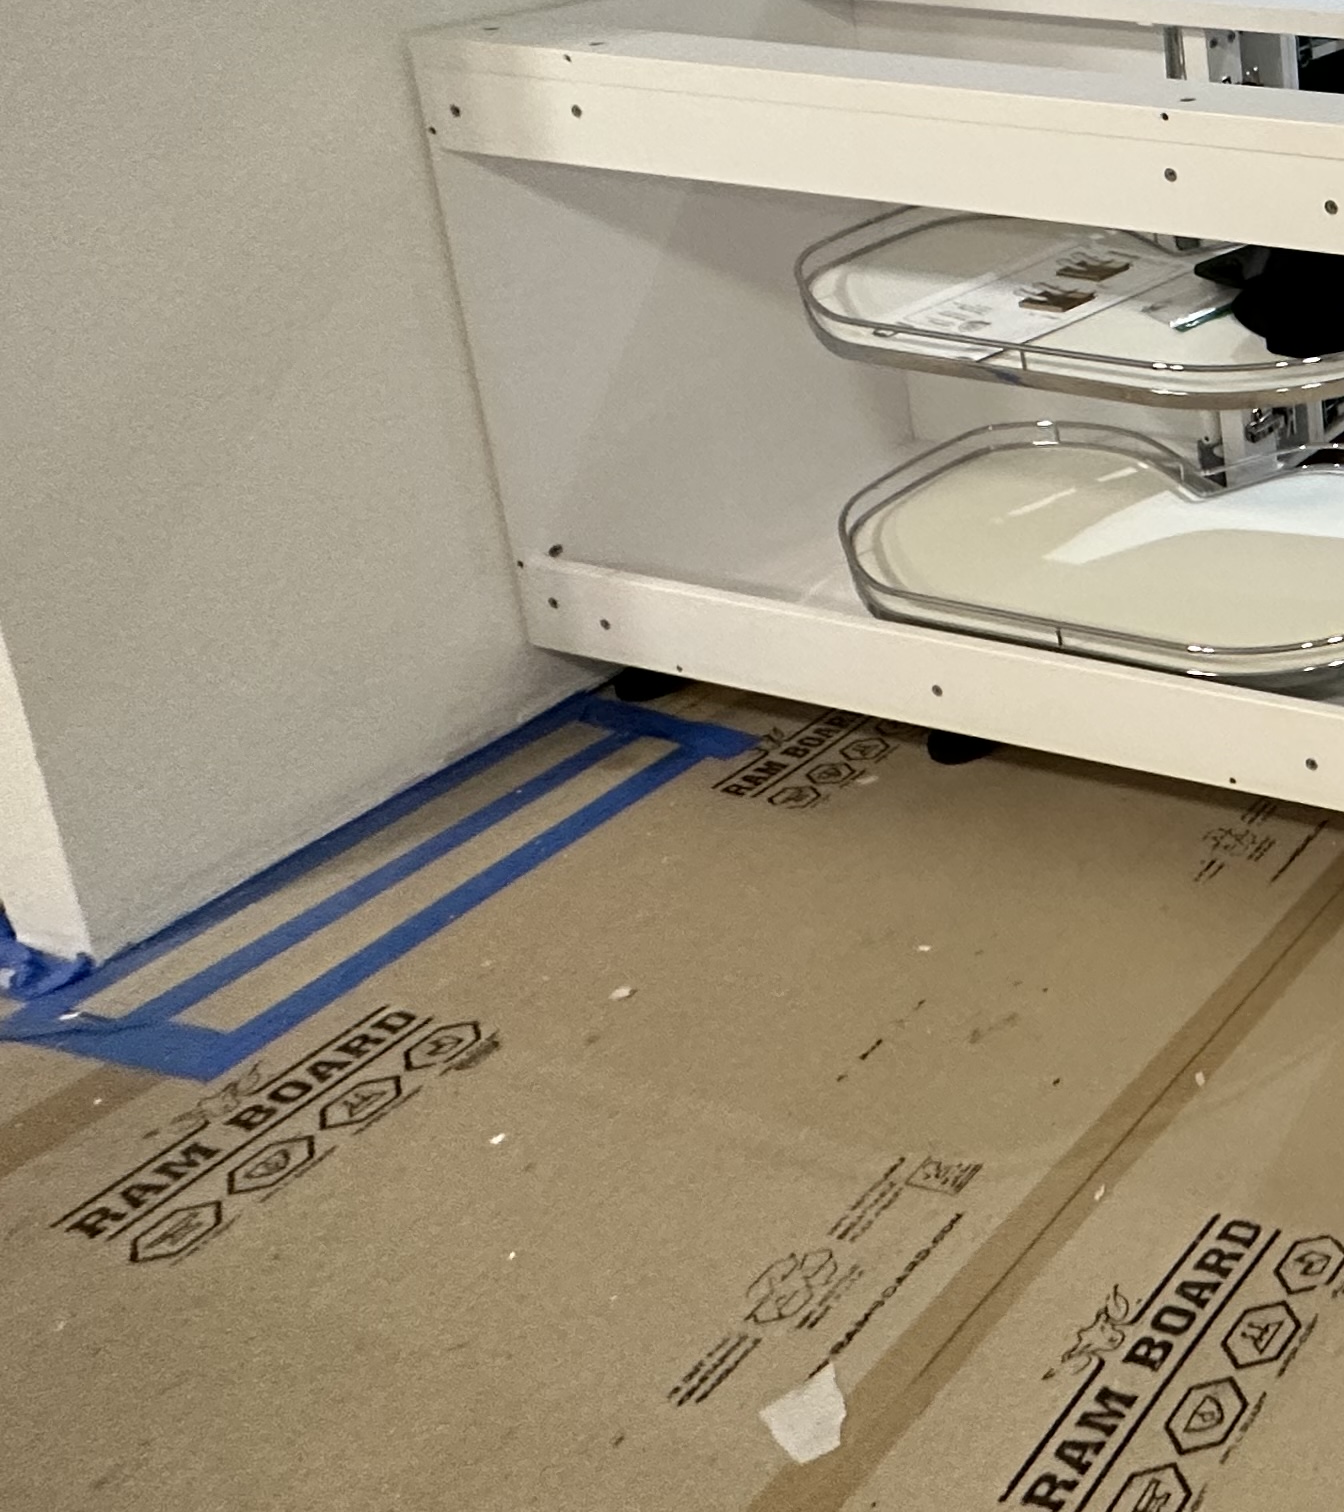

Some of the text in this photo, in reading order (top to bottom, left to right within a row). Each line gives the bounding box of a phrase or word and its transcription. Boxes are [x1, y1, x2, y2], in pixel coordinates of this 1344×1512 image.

[721, 715, 850, 796] RAM BOAR
[65, 1141, 221, 1239] RAM
[225, 1010, 418, 1131] BOARD
[1021, 1219, 1263, 1512] RAM BOARD
